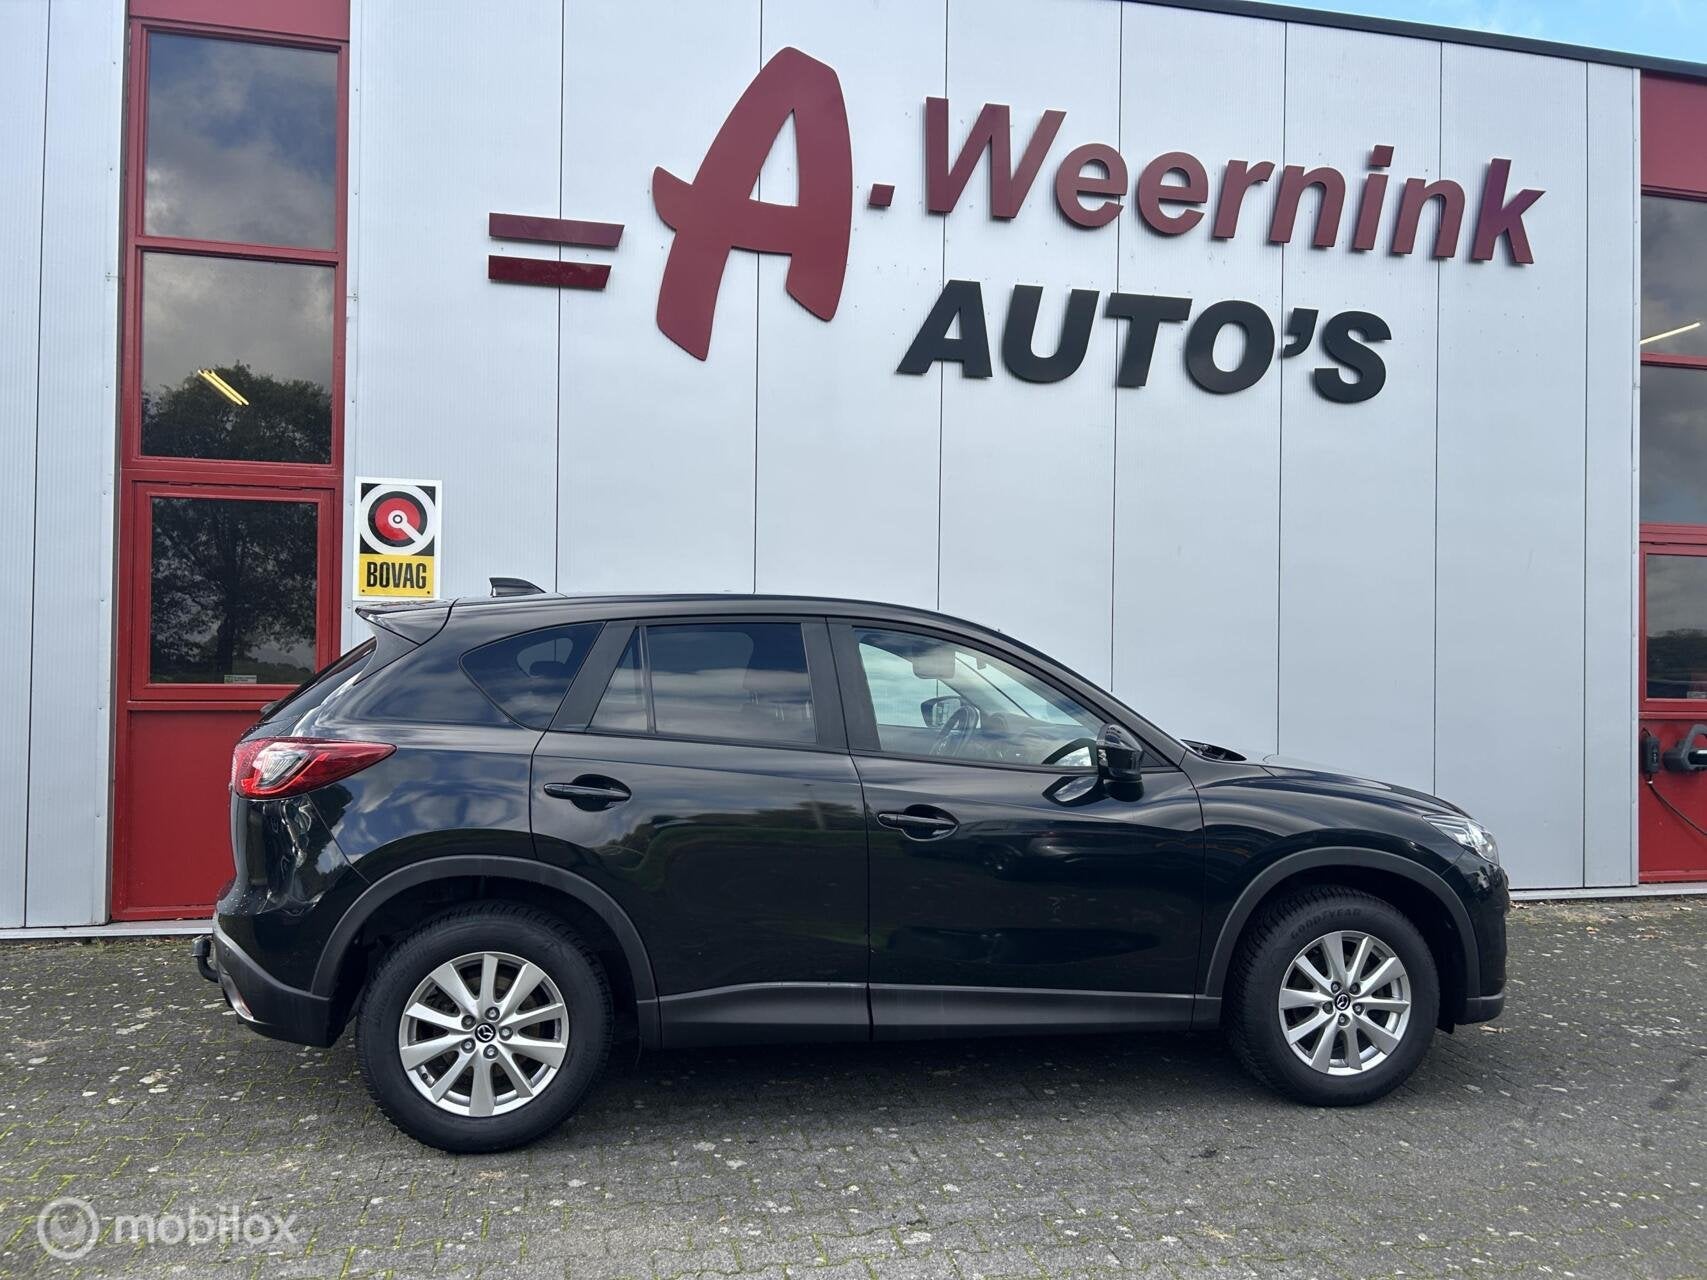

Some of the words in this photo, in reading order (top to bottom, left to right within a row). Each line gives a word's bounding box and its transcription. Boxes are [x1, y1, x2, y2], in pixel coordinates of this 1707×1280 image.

[925, 96, 1546, 265] Weernink
[896, 279, 1392, 404] AUTO'S
[366, 561, 428, 590] BOVAG
[1290, 907, 1363, 940] GOODYEAR
